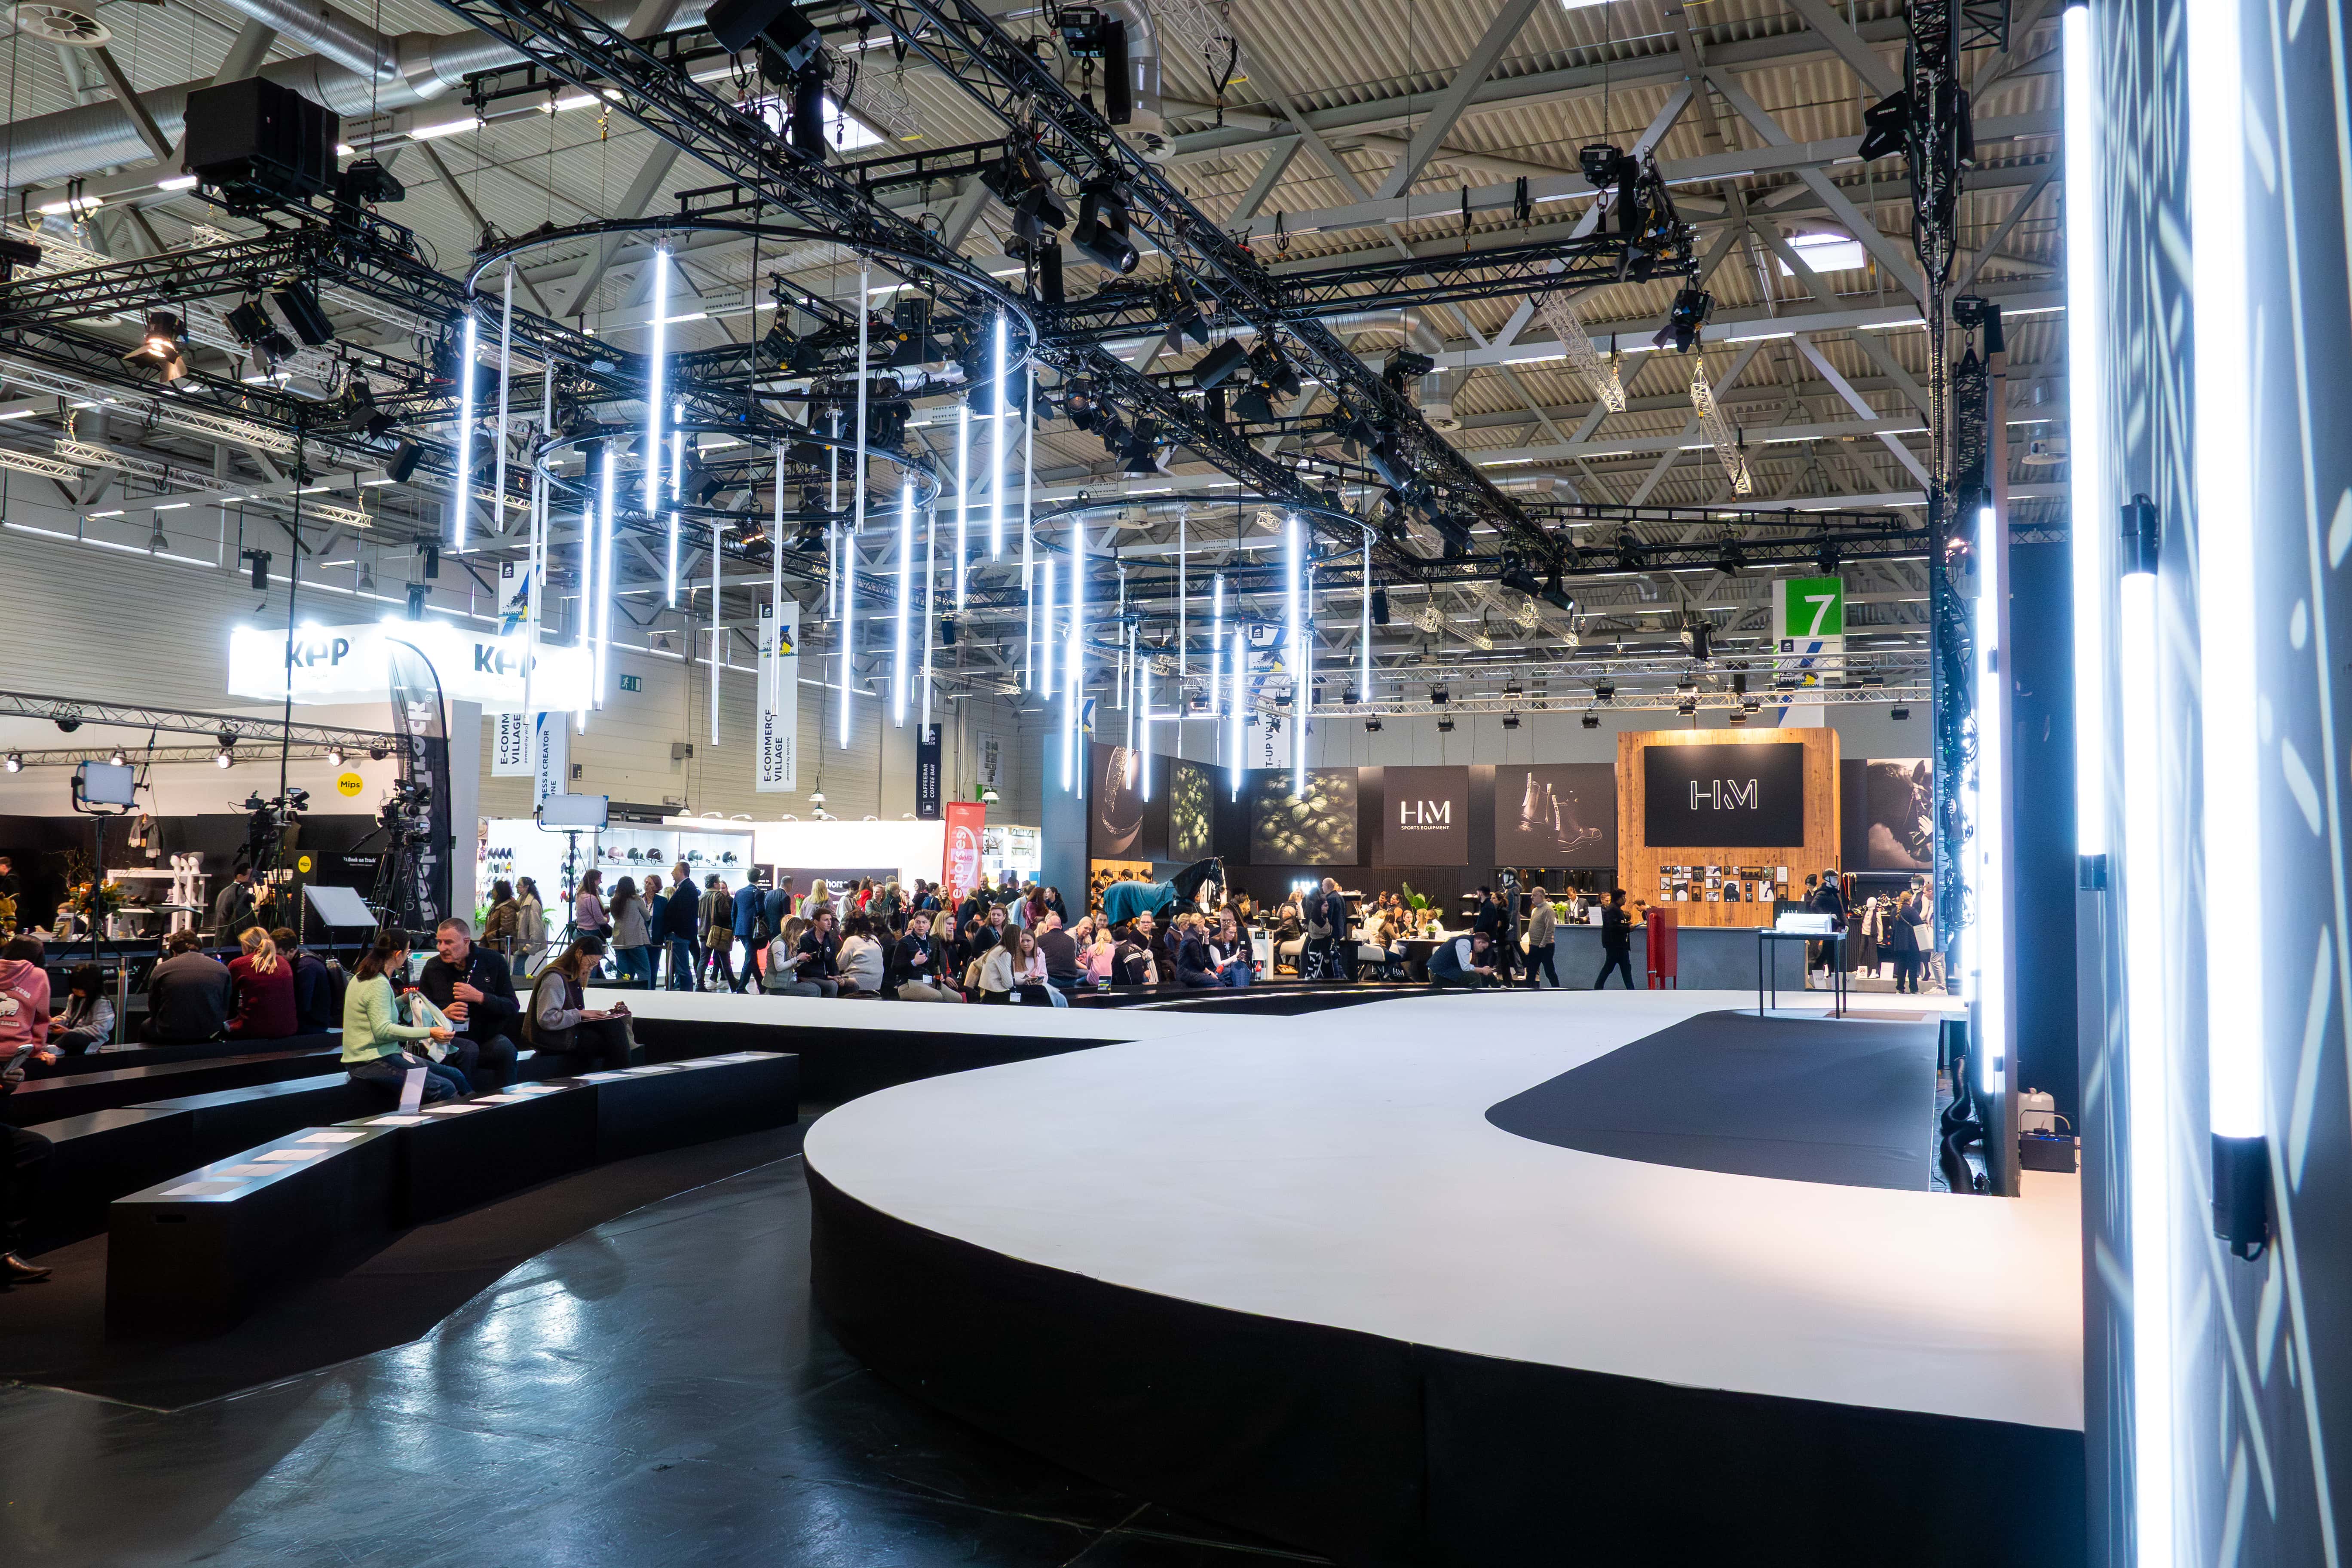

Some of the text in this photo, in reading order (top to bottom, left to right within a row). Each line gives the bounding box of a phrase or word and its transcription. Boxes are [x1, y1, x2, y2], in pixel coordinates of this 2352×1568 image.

[1804, 594, 1836, 637] 7
[511, 714, 521, 765] VILLAGE
[764, 709, 772, 782] E-COMMERCE
